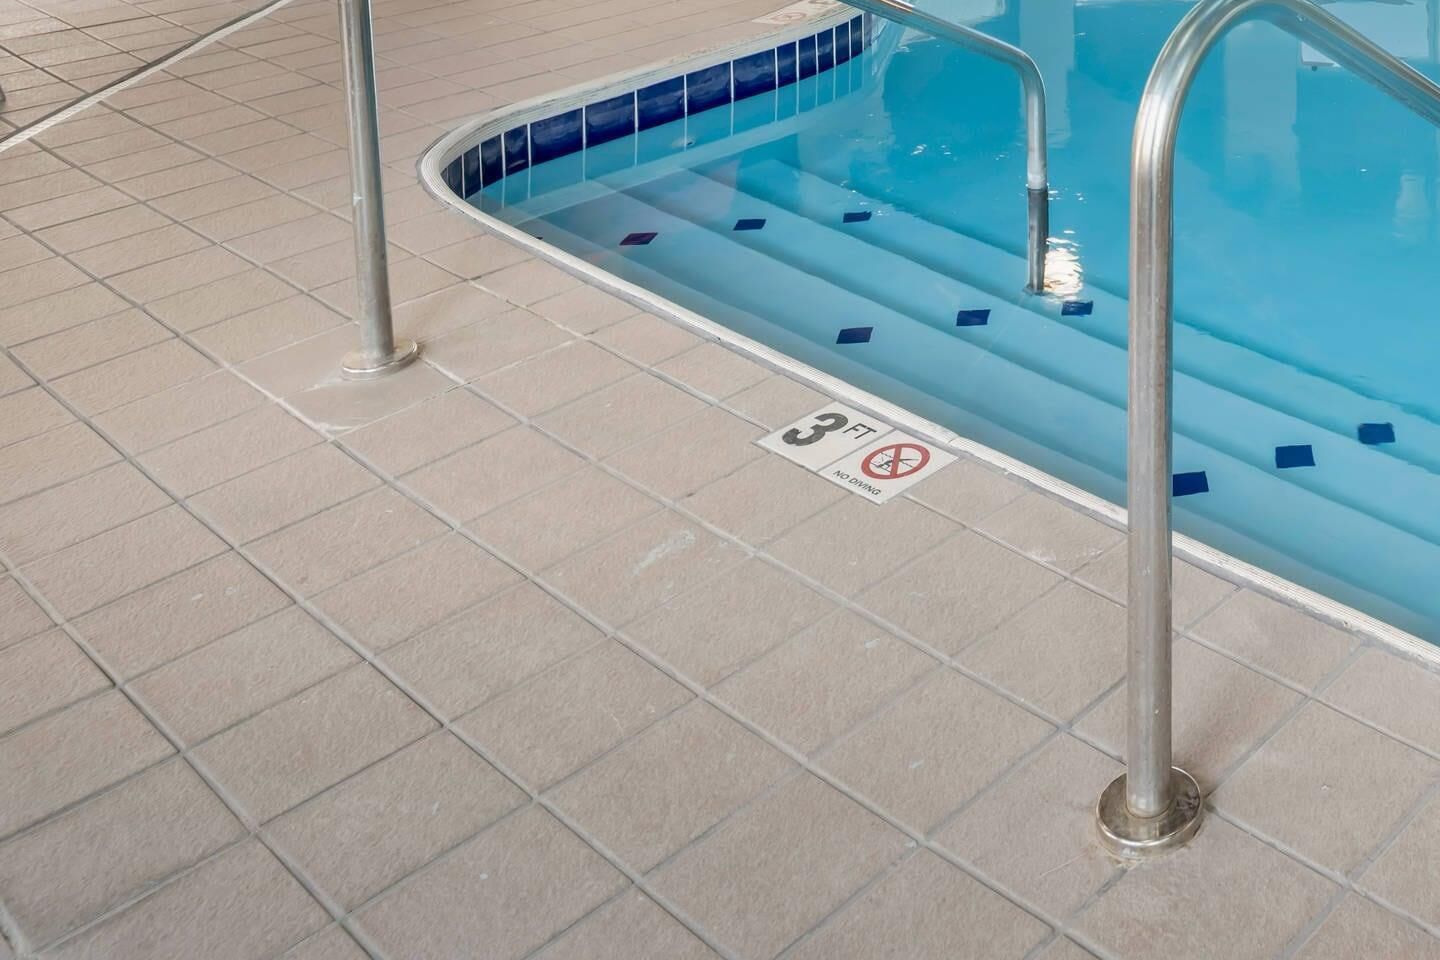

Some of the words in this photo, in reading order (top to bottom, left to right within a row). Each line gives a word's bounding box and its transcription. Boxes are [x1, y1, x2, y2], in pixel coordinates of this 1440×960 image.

[782, 412, 849, 447] 3
[842, 422, 877, 440] FT
[833, 469, 850, 480] NO
[849, 476, 882, 496] DIVING
